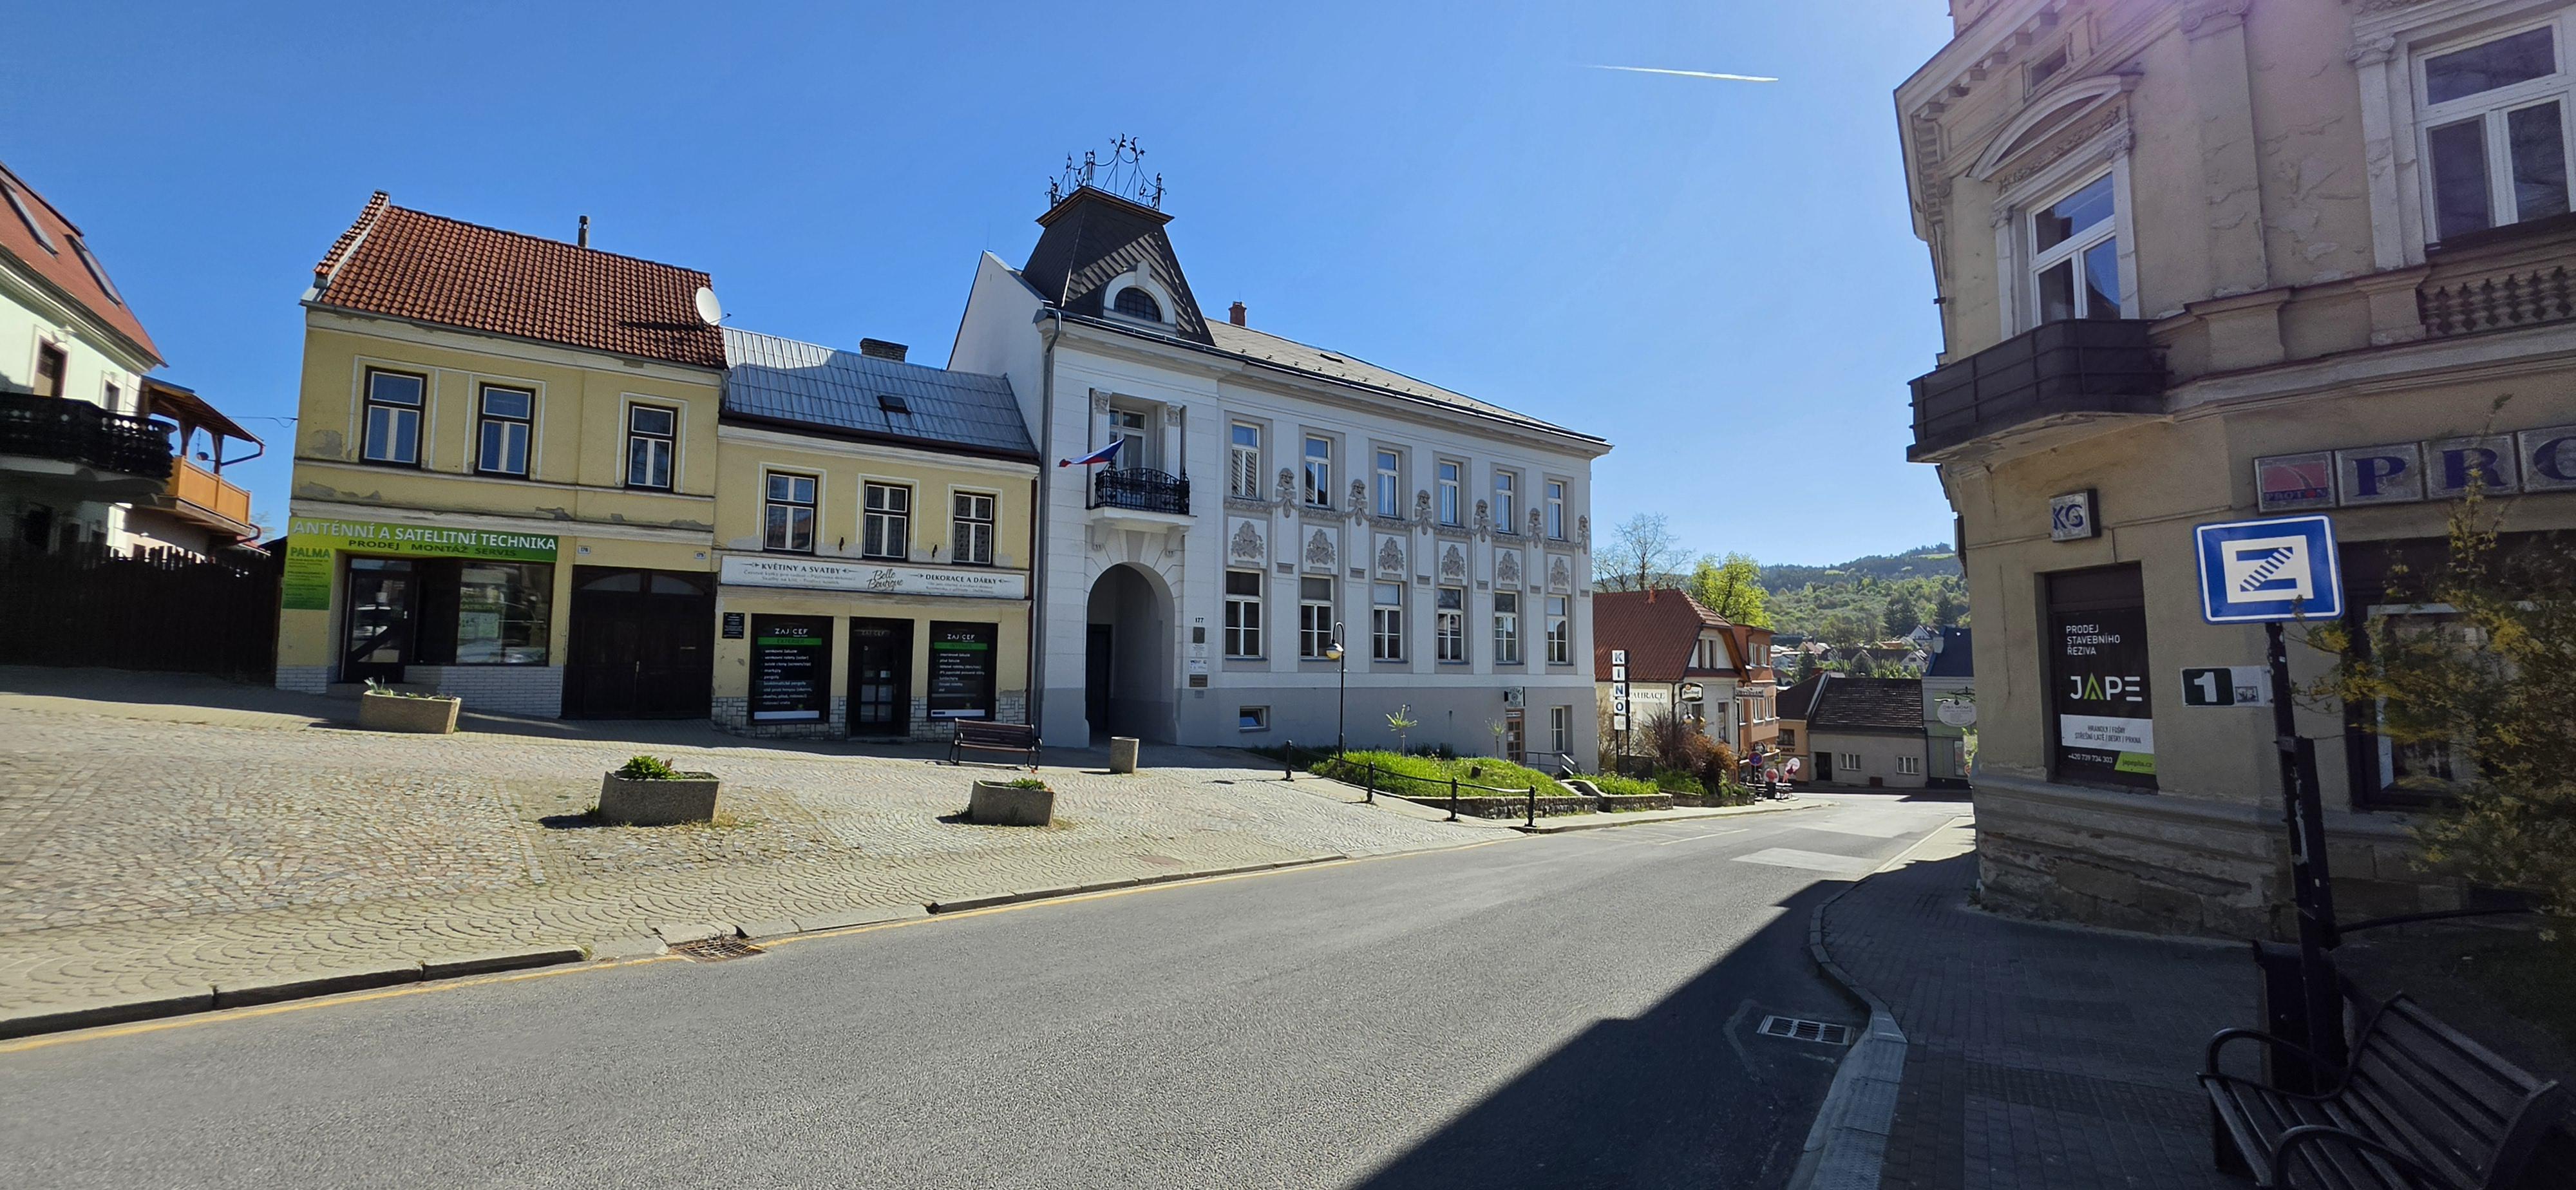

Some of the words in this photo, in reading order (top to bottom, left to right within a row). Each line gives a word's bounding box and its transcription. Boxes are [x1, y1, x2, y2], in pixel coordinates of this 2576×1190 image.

[2053, 504, 2084, 531] KG
[293, 520, 374, 538] ANTÉNNÍ
[379, 527, 390, 540] A
[395, 528, 477, 545] SATELITNÍ
[480, 534, 556, 550] TECHNIKA
[290, 547, 330, 558] PALMA
[348, 540, 400, 551] PRODEJ
[412, 543, 468, 553] MONTÁŽ
[475, 548, 516, 556] SERVIS
[761, 563, 799, 572] KVĚTINY
[873, 568, 896, 580] Belle
[925, 574, 965, 582] DEKORACE
[974, 576, 997, 585] DÁRKY
[866, 579, 904, 591] Boutique
[2066, 624, 2099, 634] PRODEJ
[2067, 632, 2121, 645] STAVEBNÍHO
[2067, 646, 2096, 655] ŘEZIVA
[1615, 652, 1624, 712] KINO
[2069, 672, 2143, 702] JAPE
[2193, 672, 2217, 702] 1
[2112, 725, 2126, 733] FOŠNY
